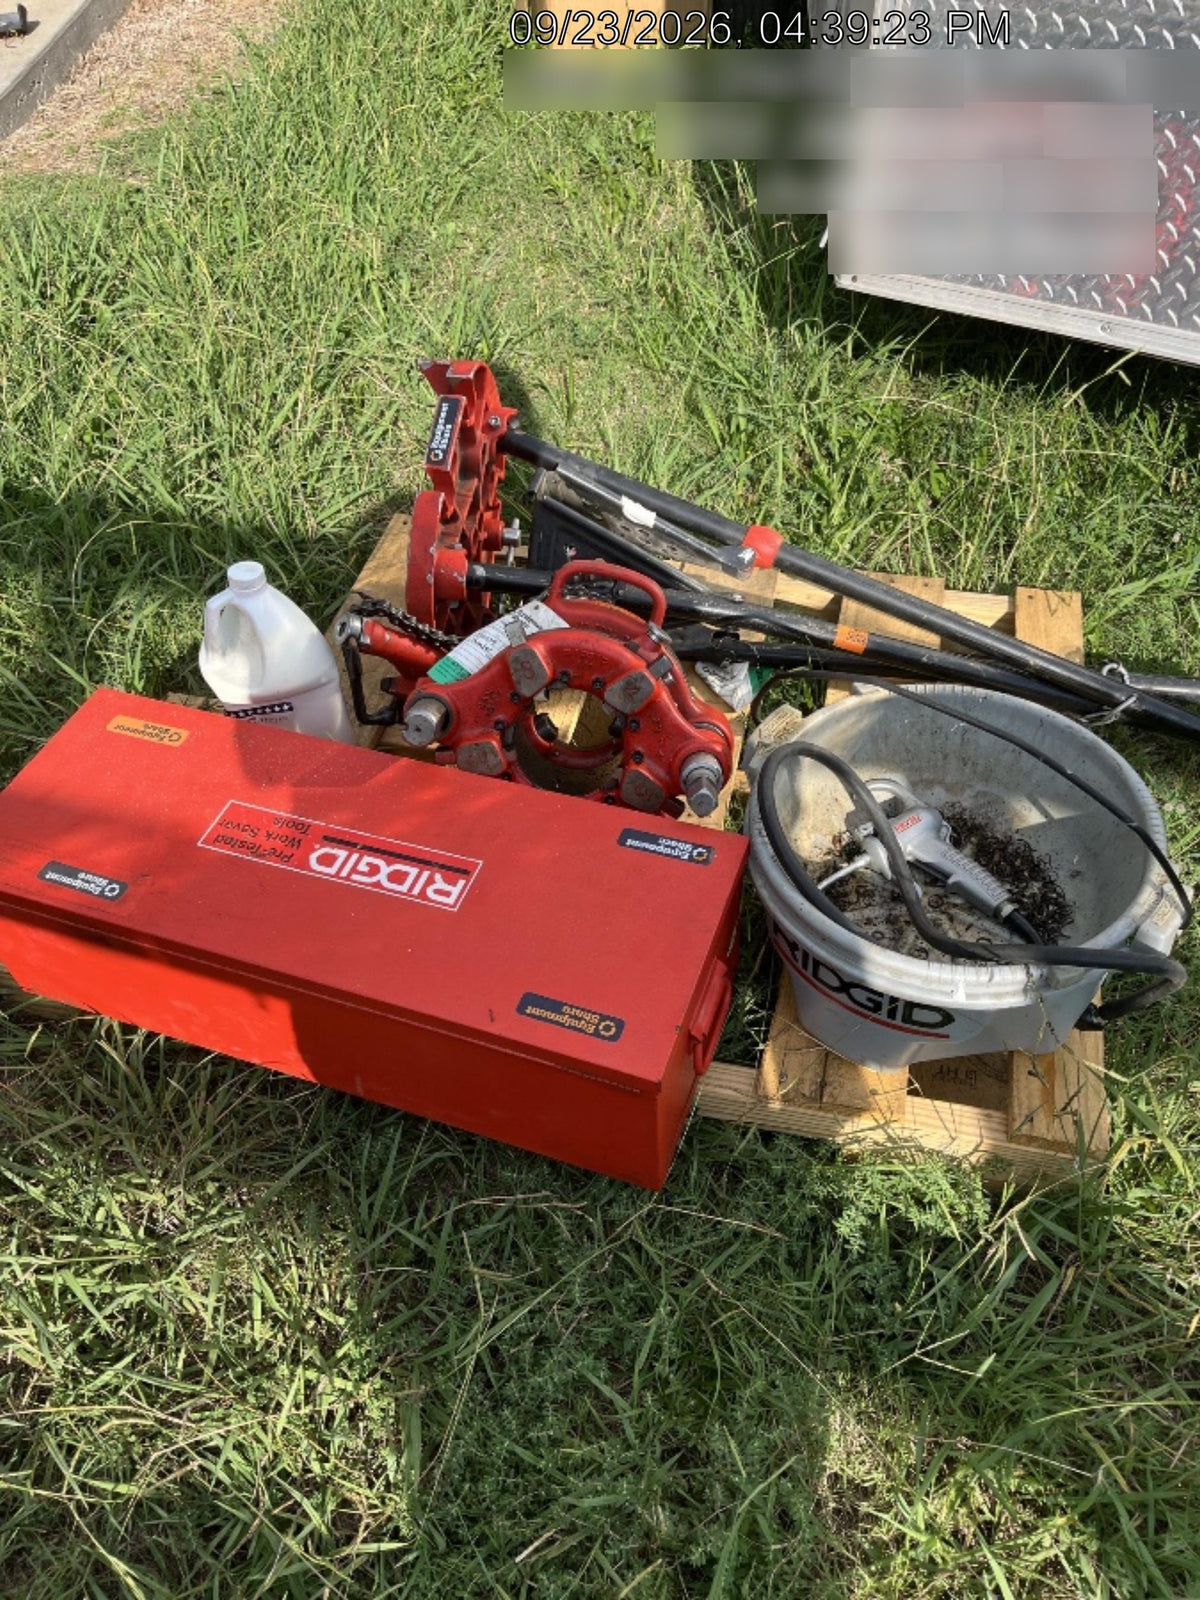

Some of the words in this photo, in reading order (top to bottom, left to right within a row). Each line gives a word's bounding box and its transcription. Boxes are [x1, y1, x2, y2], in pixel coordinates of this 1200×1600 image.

[273, 816, 312, 836] Tools
[266, 829, 303, 849] Work
[308, 846, 466, 905] RIDGID
[525, 1006, 596, 1034] Equipment
